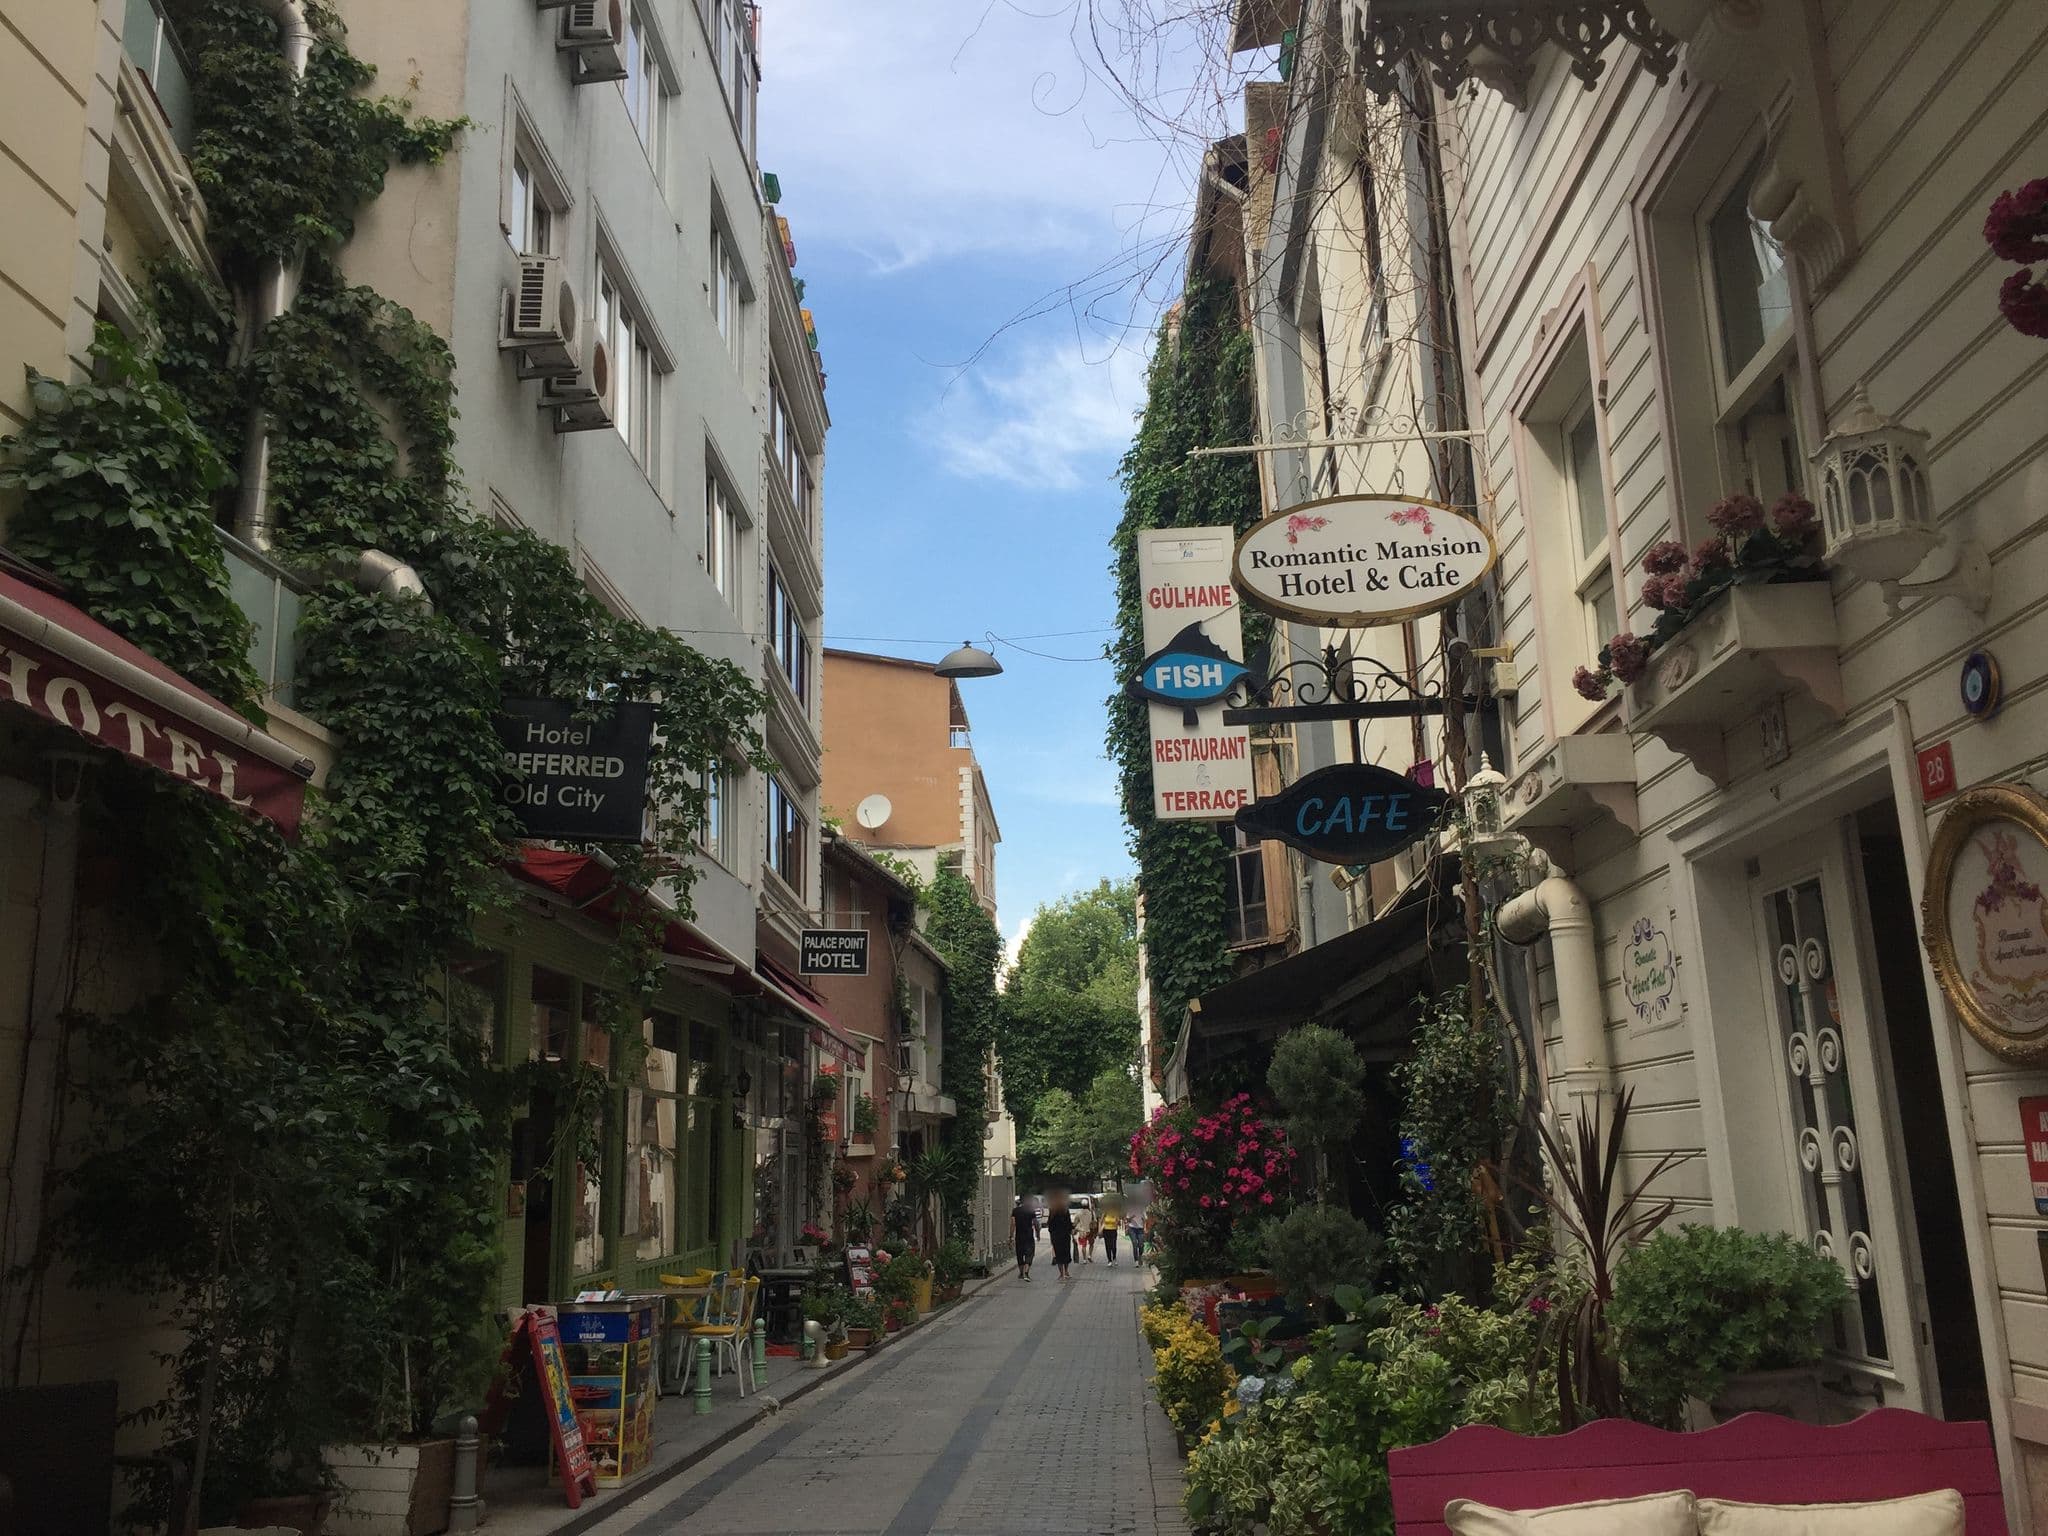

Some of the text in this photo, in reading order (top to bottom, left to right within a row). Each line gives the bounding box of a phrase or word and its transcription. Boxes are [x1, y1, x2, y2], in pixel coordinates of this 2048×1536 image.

[1251, 536, 1482, 569] Romantic Mansion
[1278, 562, 1460, 598] Hotel & Cafe
[1149, 582, 1233, 610] GÜLHANE
[1155, 663, 1223, 690] FISH
[0, 645, 253, 806] HOTEL
[526, 722, 592, 746] Hotel
[1155, 736, 1246, 763] RESTAURANT
[1926, 756, 1945, 786] 28
[503, 783, 605, 813] Old City
[1162, 789, 1247, 812] TERRACE
[1296, 793, 1411, 836] CAFE
[804, 936, 865, 950] PALACE POINT
[807, 952, 861, 968] HOTEL
